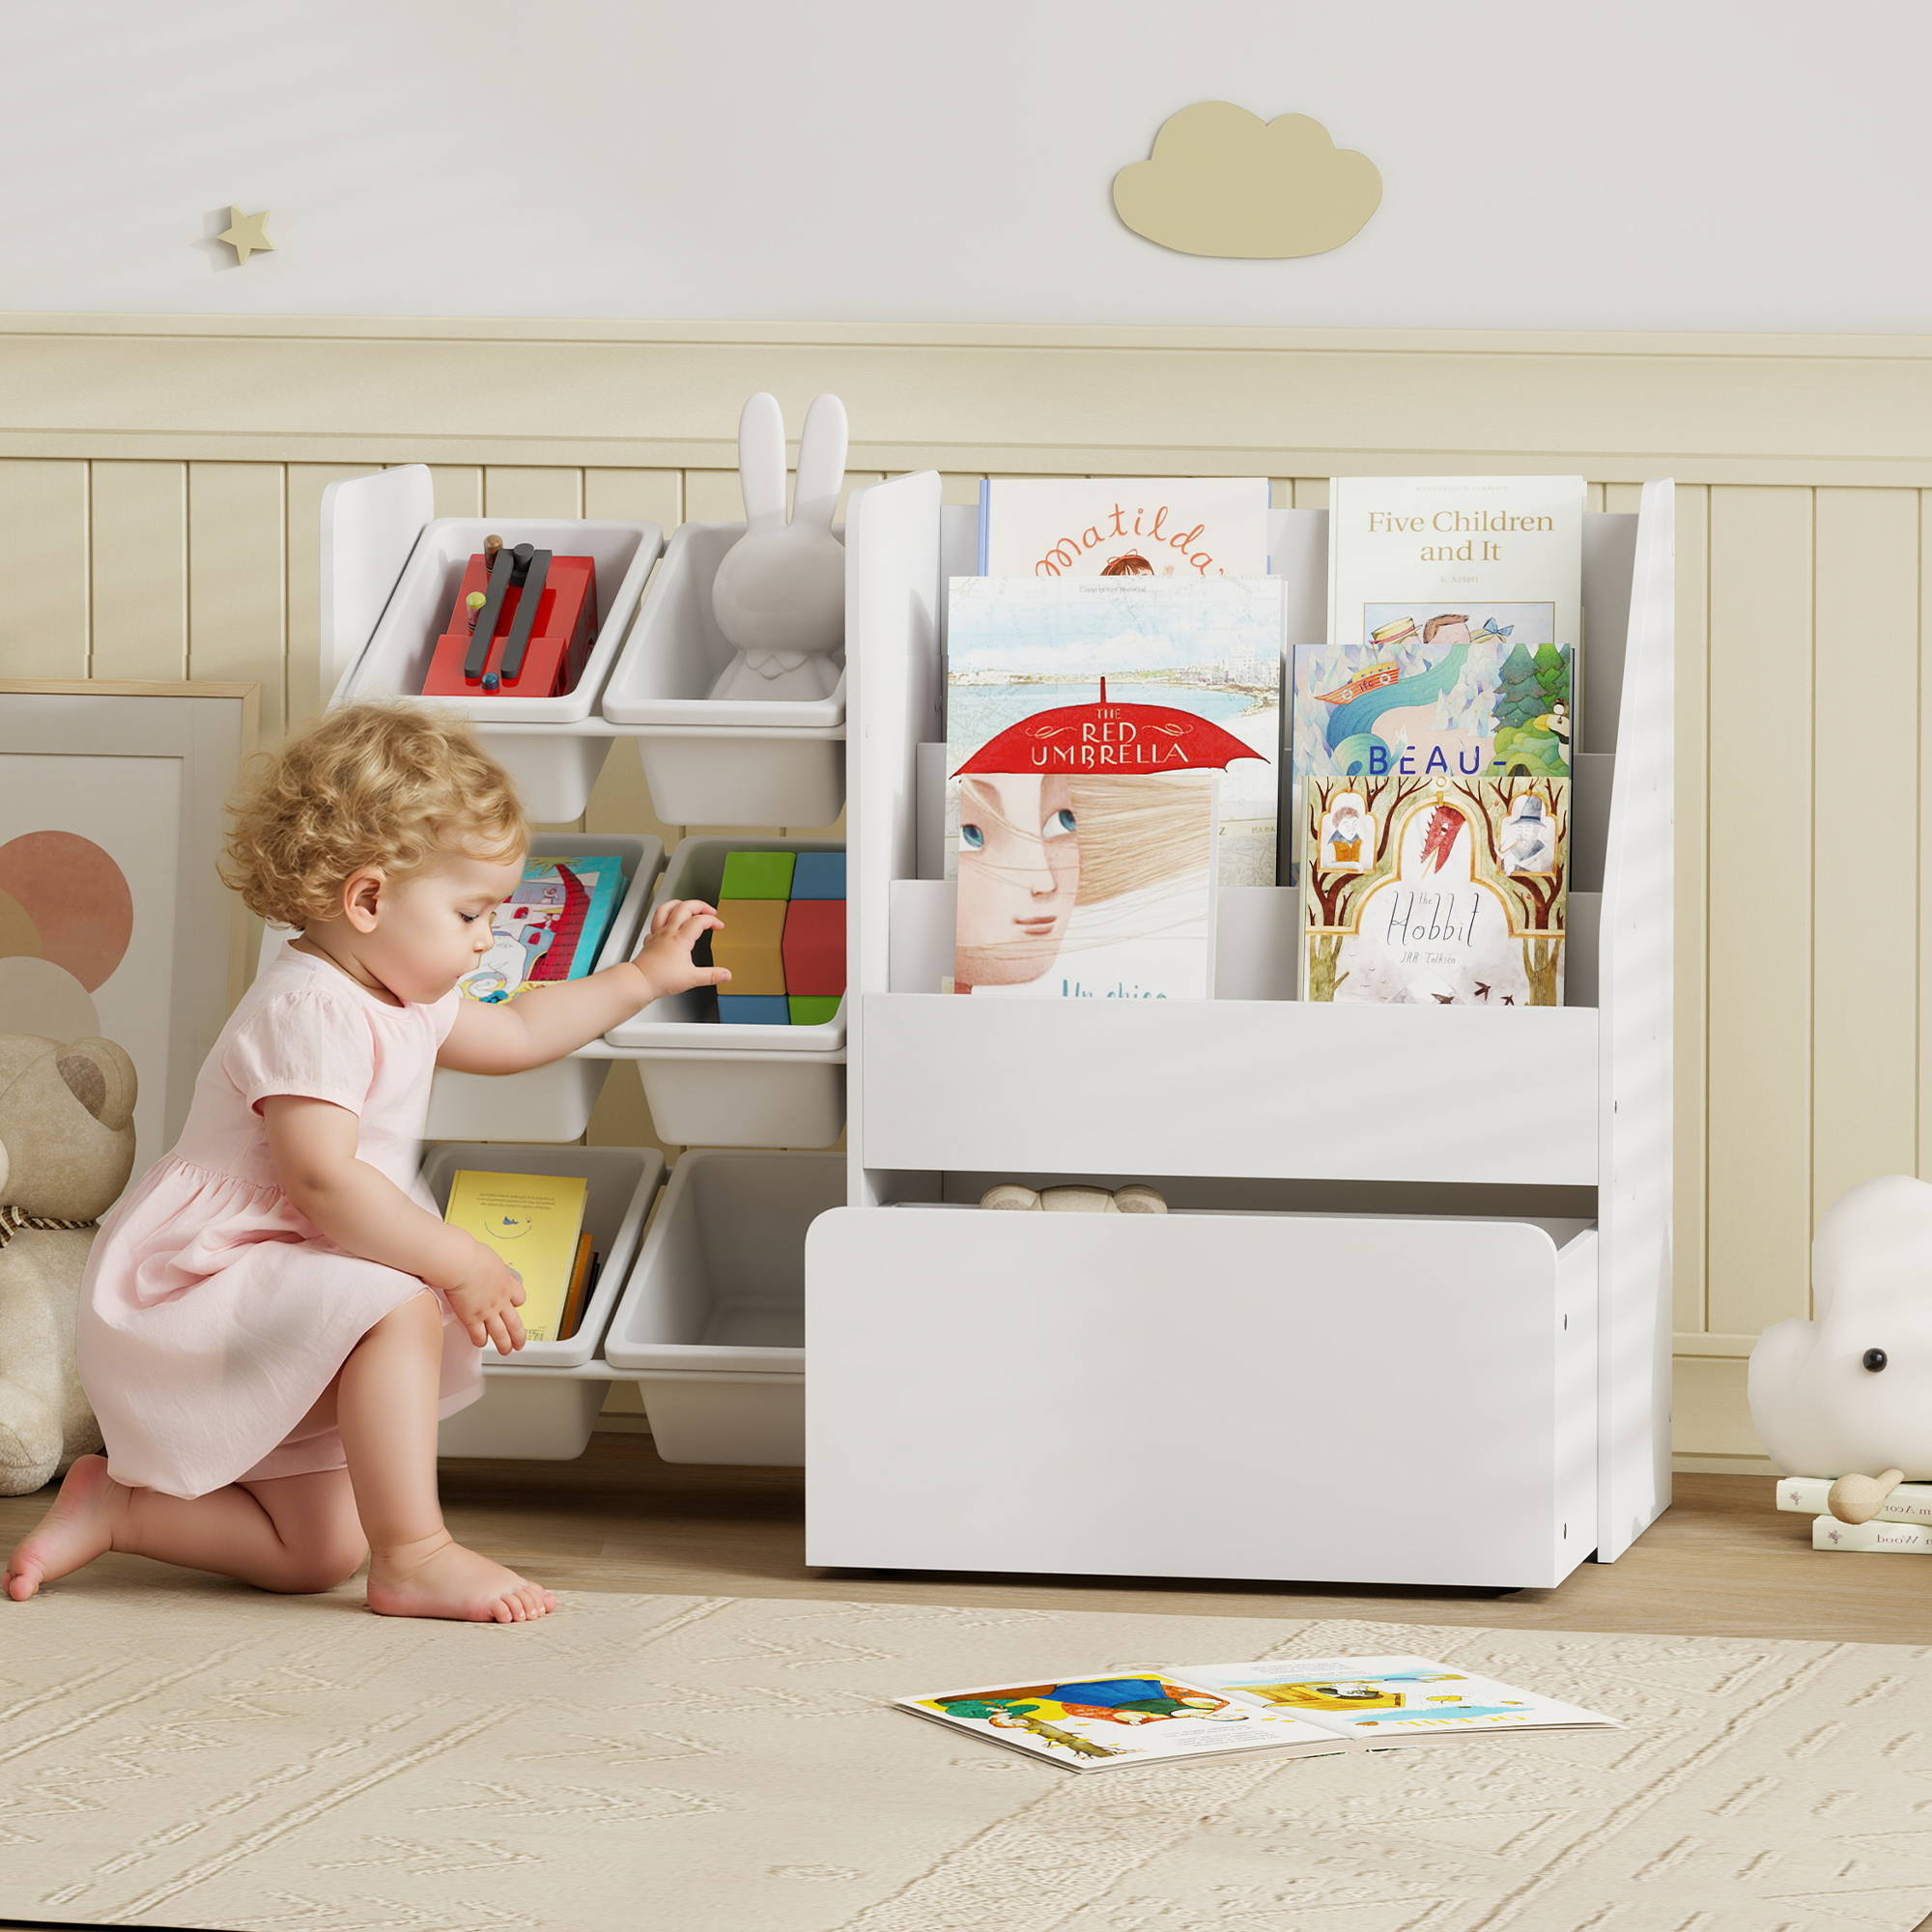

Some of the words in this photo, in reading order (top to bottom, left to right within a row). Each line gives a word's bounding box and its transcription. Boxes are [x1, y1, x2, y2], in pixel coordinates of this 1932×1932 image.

[1368, 511, 1425, 532] Five
[1433, 510, 1554, 532] Children
[1420, 539, 1473, 561] and
[1481, 540, 1501, 561] It
[1096, 708, 1122, 720] THE
[1083, 722, 1137, 743] RED
[1032, 743, 1189, 769] UMBRELLA
[1419, 892, 1433, 904] the
[1387, 891, 1480, 948] Hobbit
[1400, 952, 1420, 964] JRR
[1425, 952, 1456, 964] Tolkien
